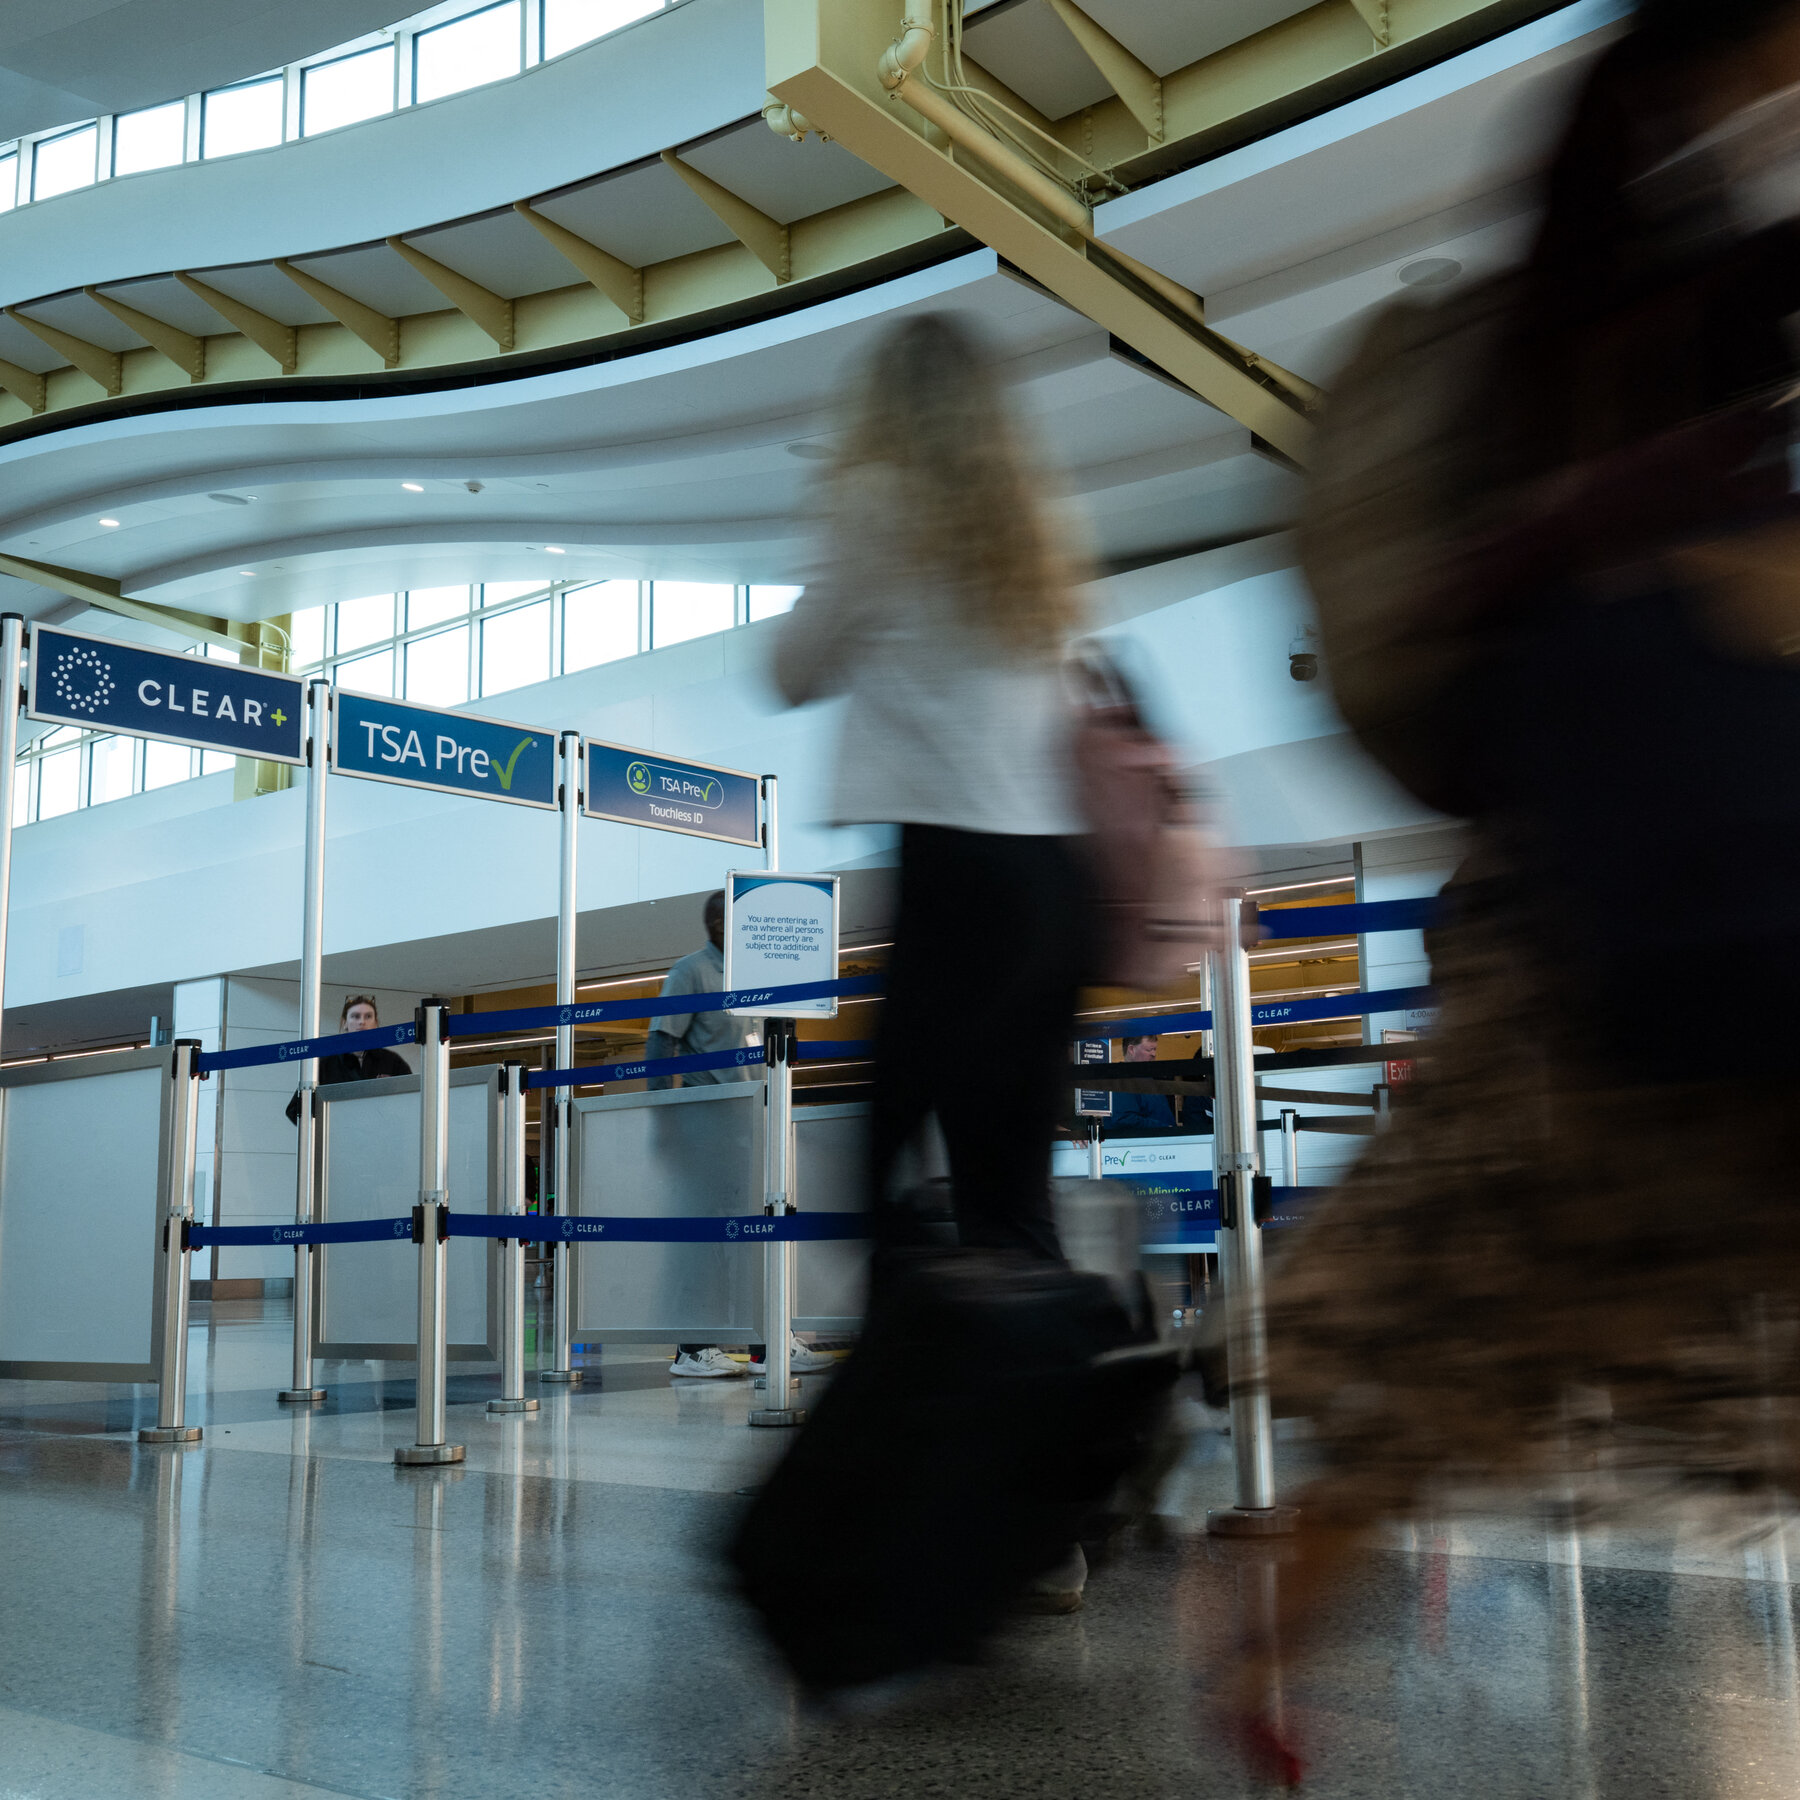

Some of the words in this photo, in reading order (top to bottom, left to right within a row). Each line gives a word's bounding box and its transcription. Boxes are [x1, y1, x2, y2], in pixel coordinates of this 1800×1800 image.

[360, 720, 426, 768] TSA
[660, 776, 681, 793] TSA
[649, 803, 692, 822] Touchless
[693, 812, 703, 824] ID
[748, 915, 762, 923] You
[763, 916, 776, 924] are
[777, 917, 808, 926] entering
[741, 924, 758, 932] area
[760, 924, 783, 933] where
[785, 925, 794, 933] all
[795, 926, 824, 934] persons
[752, 933, 766, 941] and
[767, 935, 800, 943] property
[745, 942, 772, 950] subject
[782, 943, 819, 951] additional
[740, 993, 773, 1003] CLEAR
[574, 1008, 603, 1018] CLEAR
[1257, 1008, 1291, 1019] CLEAR
[289, 1045, 309, 1055] CLEAR
[748, 1051, 765, 1059] CLE
[625, 1066, 646, 1075] CLEAR
[1390, 1062, 1412, 1080] Exit
[1170, 1199, 1213, 1212] CLEAR
[577, 1224, 605, 1233] CLEAR
[743, 1224, 775, 1234] CLEAR
[283, 1230, 304, 1239] CLEAR
